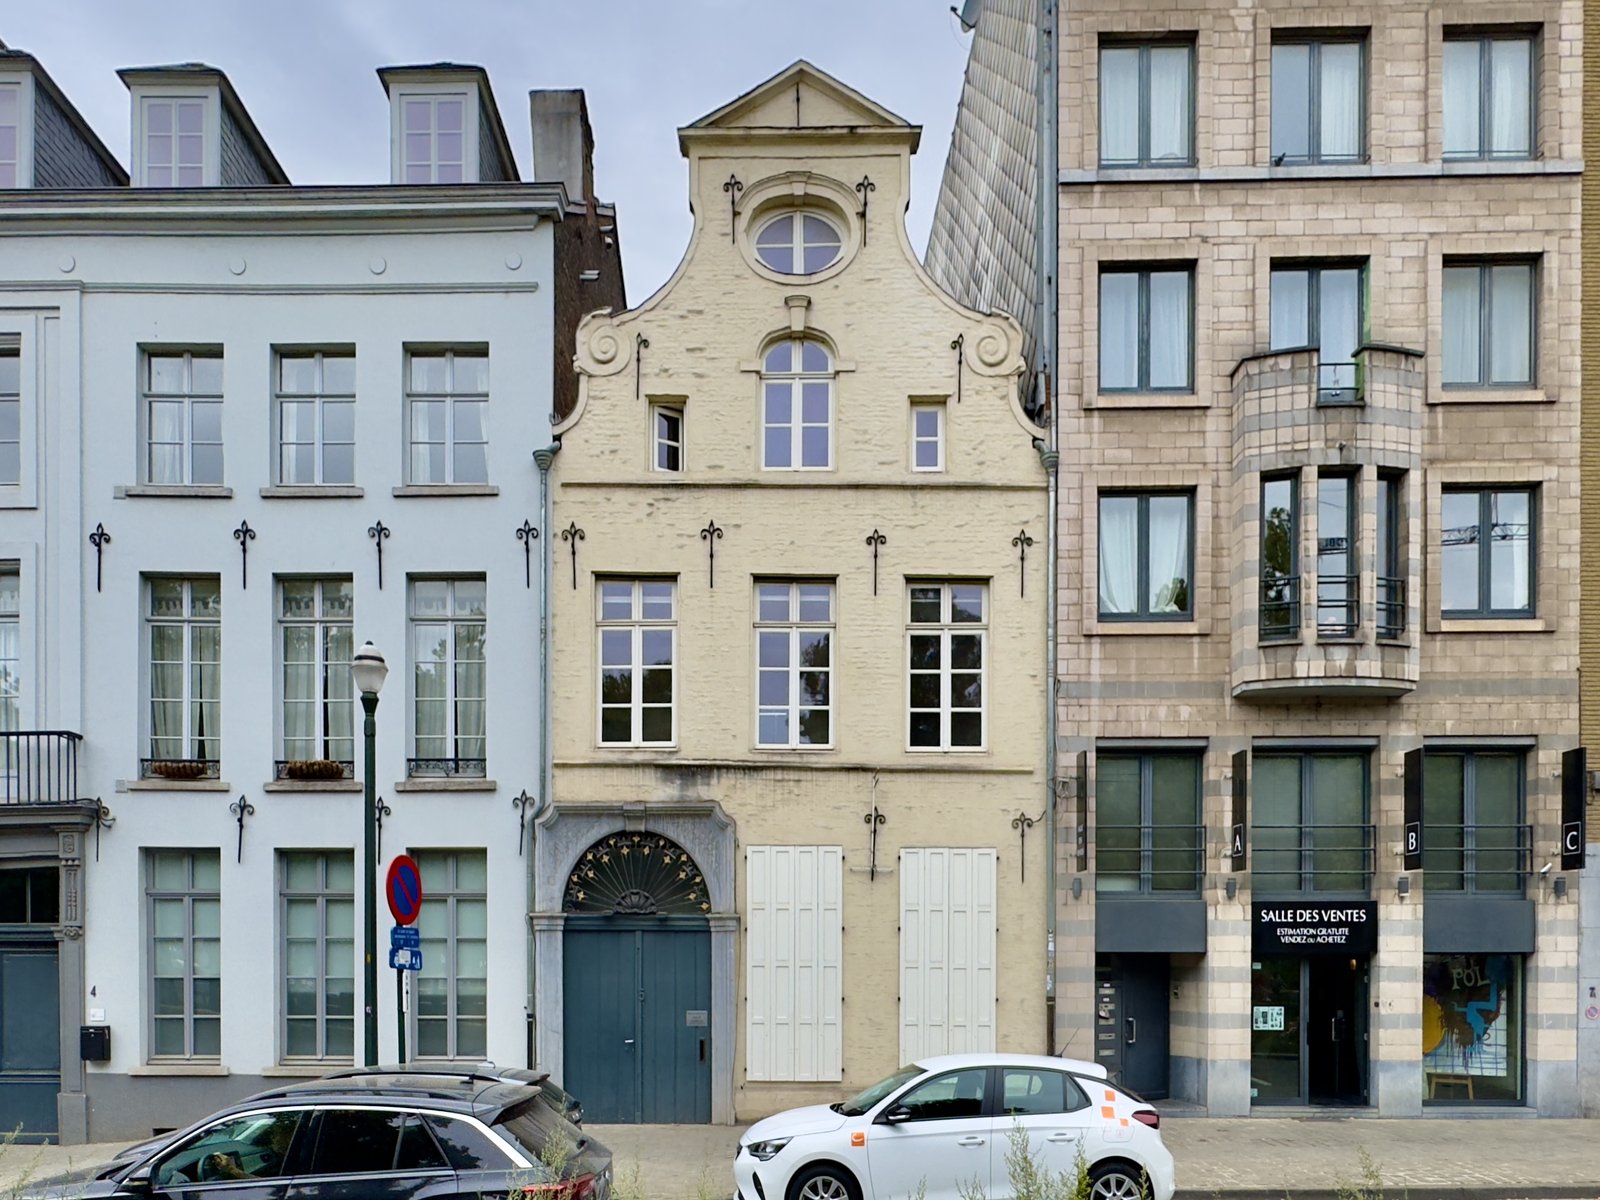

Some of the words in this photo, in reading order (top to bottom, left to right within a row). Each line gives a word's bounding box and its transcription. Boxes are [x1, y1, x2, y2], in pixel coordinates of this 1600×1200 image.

[1234, 833, 1241, 851] A
[1408, 832, 1416, 850] B
[1566, 831, 1578, 850] C
[1261, 909, 1294, 922] SALLE
[1296, 909, 1320, 922] DES
[1321, 909, 1367, 922] VENTES
[90, 984, 96, 998] 4
